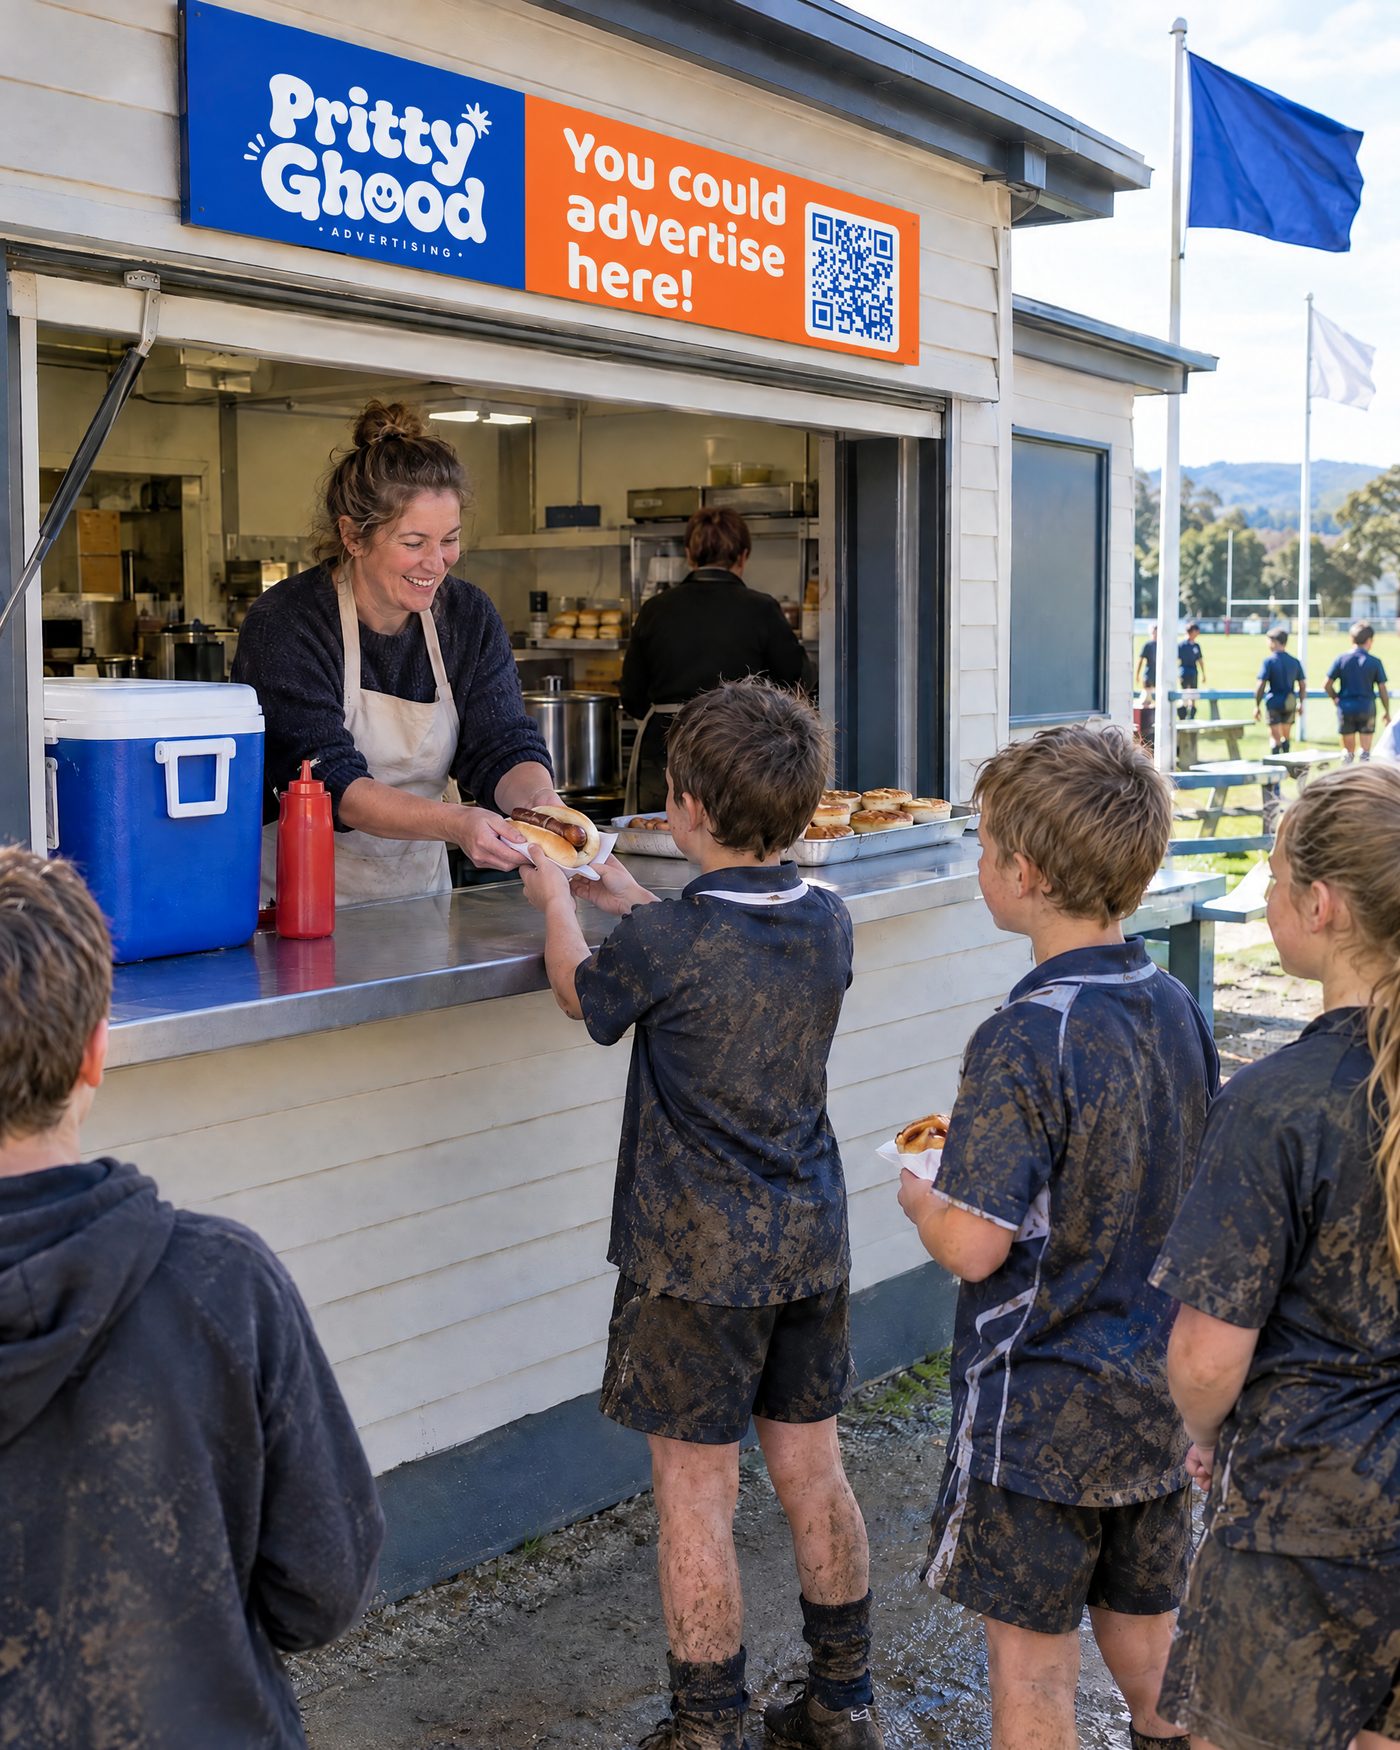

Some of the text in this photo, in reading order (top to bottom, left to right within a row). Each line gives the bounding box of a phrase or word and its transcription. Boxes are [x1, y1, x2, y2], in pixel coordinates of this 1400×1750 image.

[269, 74, 476, 187] Pritty
[261, 143, 487, 244] Ghood
[563, 128, 786, 226] You could
[332, 227, 451, 258] ADVERTISING
[567, 195, 786, 278] advertise
[569, 242, 693, 313] here!
